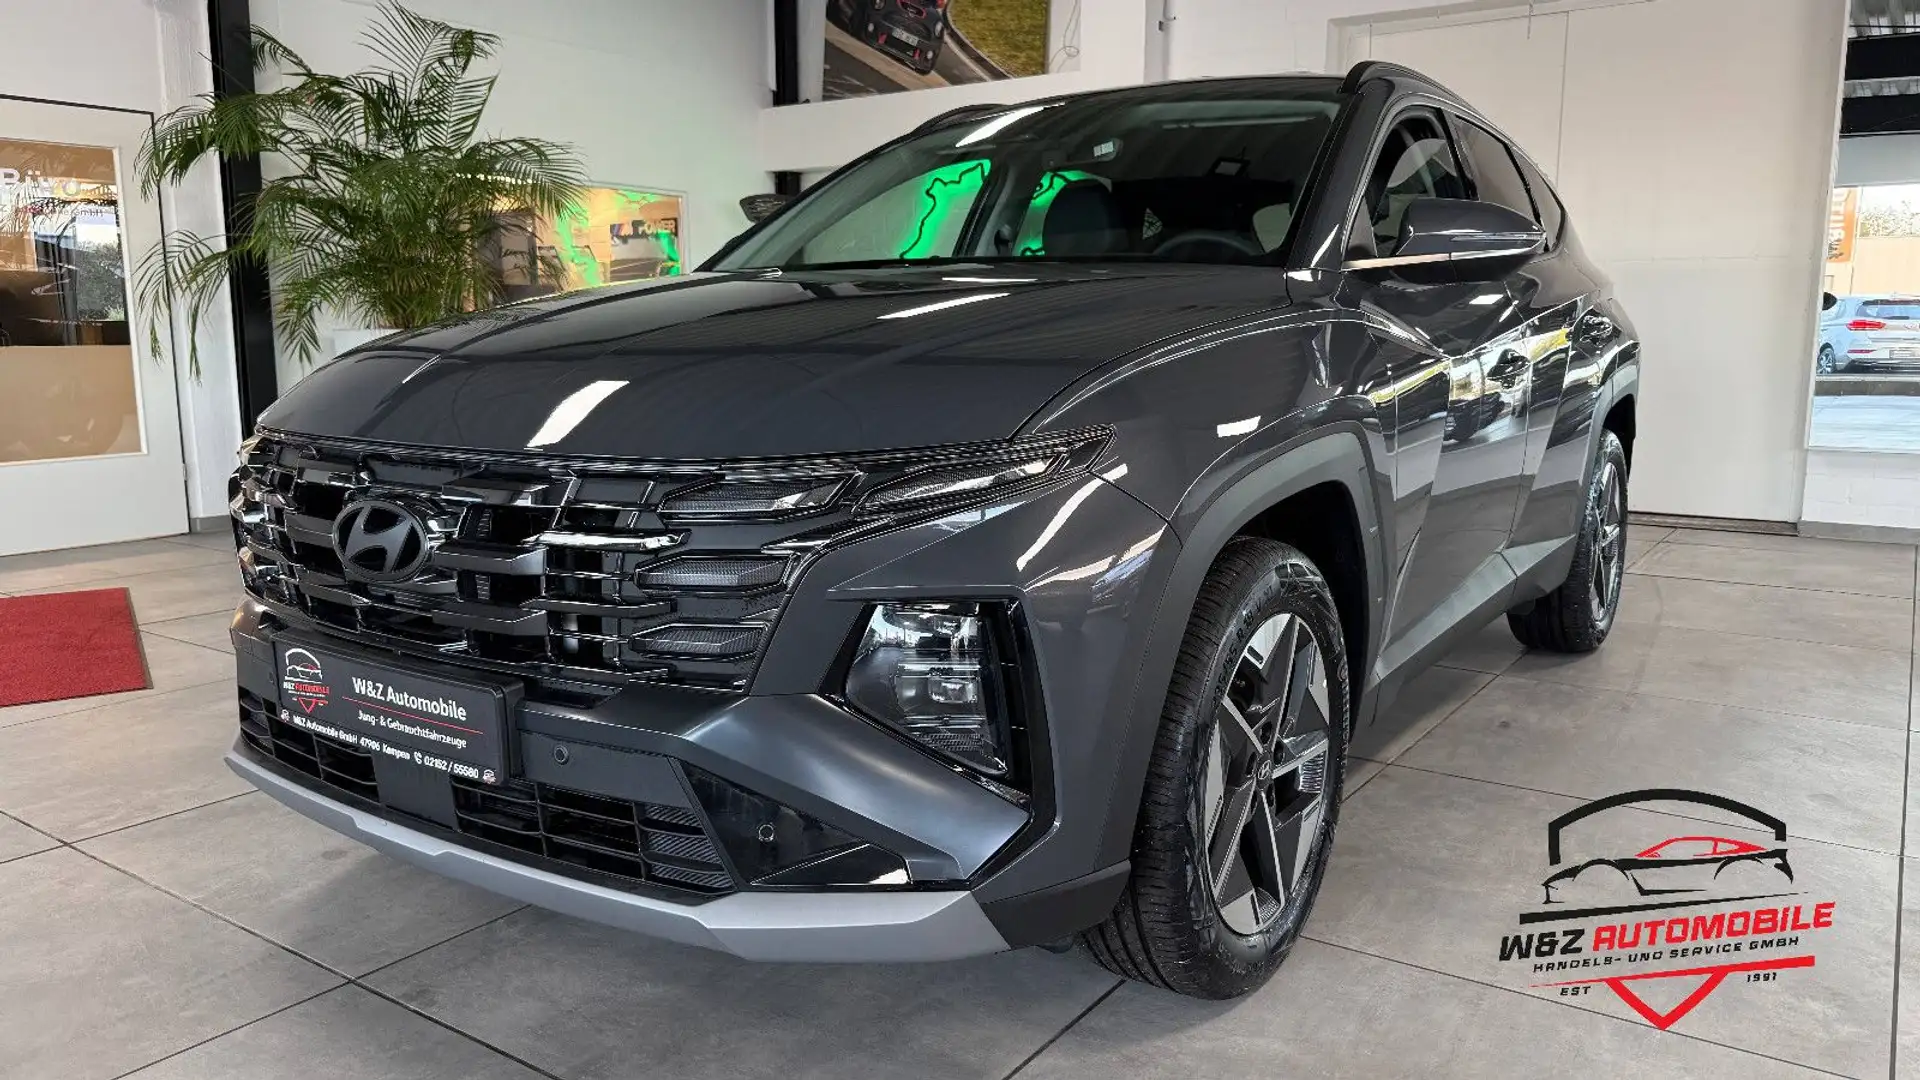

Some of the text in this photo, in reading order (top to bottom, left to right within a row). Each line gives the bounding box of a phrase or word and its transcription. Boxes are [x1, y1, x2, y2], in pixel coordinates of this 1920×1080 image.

[352, 676, 467, 721] W&Z Automobile
[293, 714, 306, 726] W&Z
[306, 718, 339, 738] Automobile
[339, 727, 358, 744] GmbH
[359, 735, 381, 751] 47906
[382, 743, 411, 760] Kempen
[357, 709, 467, 748] Jung- & Gebrauchtfahrzeuge
